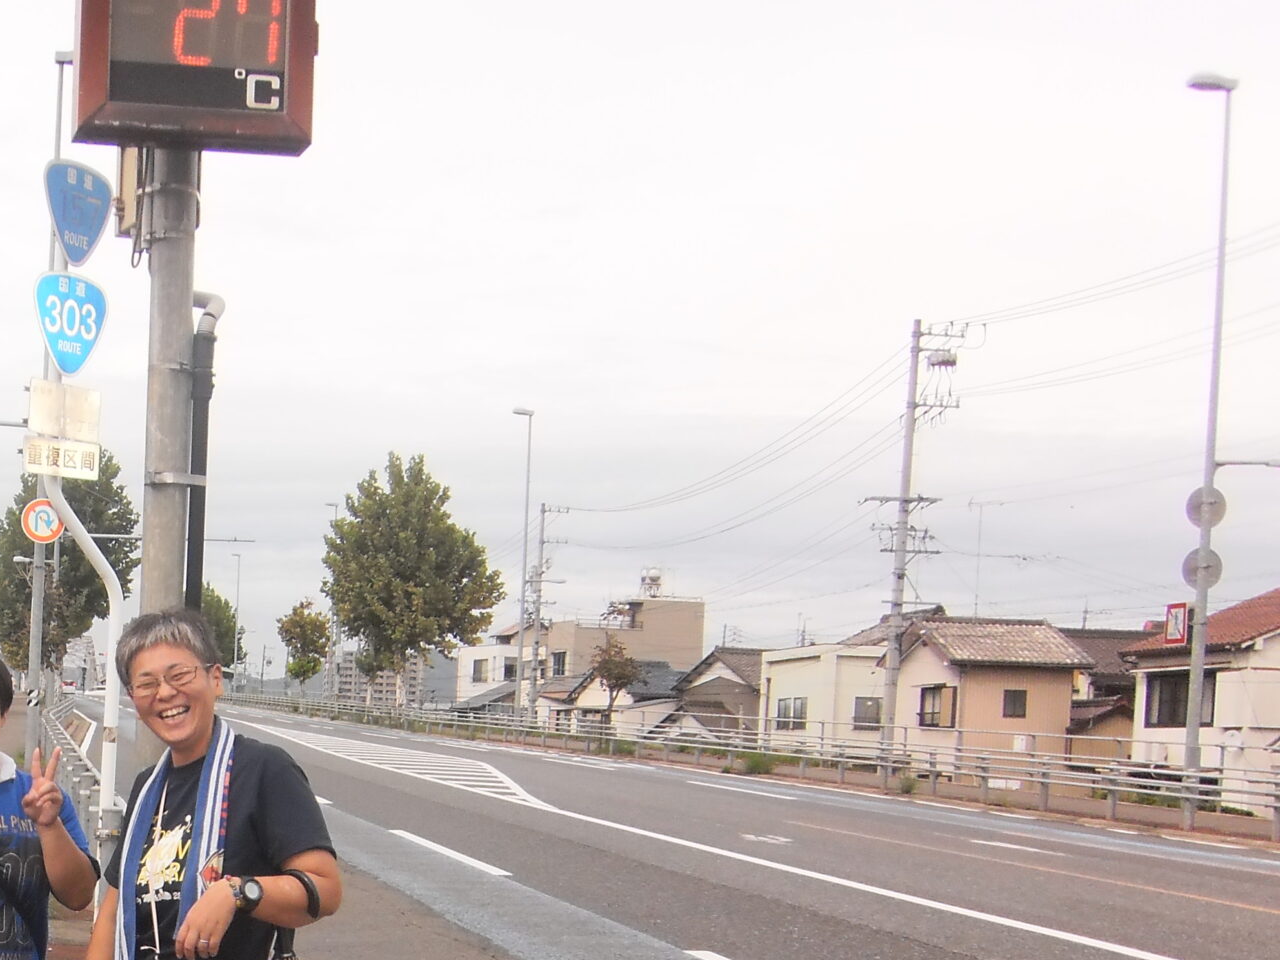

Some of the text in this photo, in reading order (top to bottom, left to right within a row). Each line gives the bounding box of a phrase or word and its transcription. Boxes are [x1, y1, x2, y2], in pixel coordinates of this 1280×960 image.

[64, 230, 89, 249] ROUTE
[45, 295, 97, 341] 303
[58, 339, 82, 355] ROUTE
[27, 444, 95, 471] 重複区間
